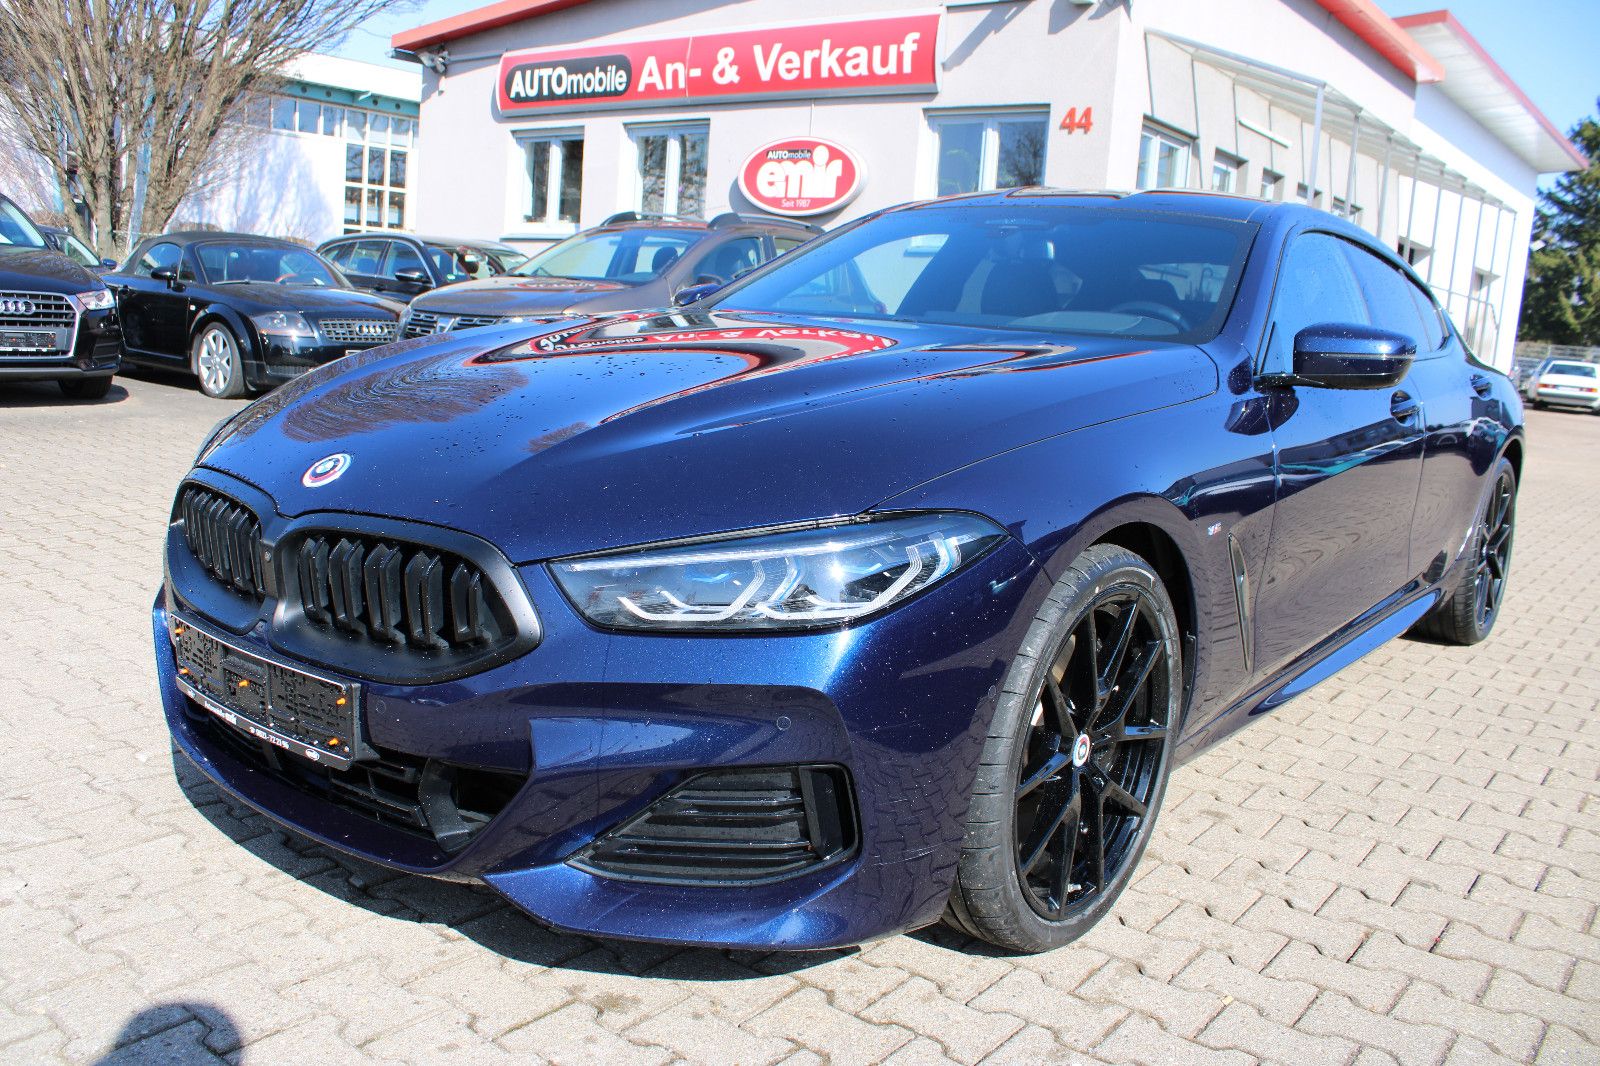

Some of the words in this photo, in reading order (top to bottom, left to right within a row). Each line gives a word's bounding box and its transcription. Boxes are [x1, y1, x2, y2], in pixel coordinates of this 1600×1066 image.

[510, 64, 628, 98] AUTOmobile
[637, 55, 702, 92] An-
[712, 47, 741, 85] &
[753, 32, 921, 82] Verkauf
[1059, 106, 1093, 135] 44
[756, 145, 843, 199] emir
[767, 149, 812, 160] AUTOmobile
